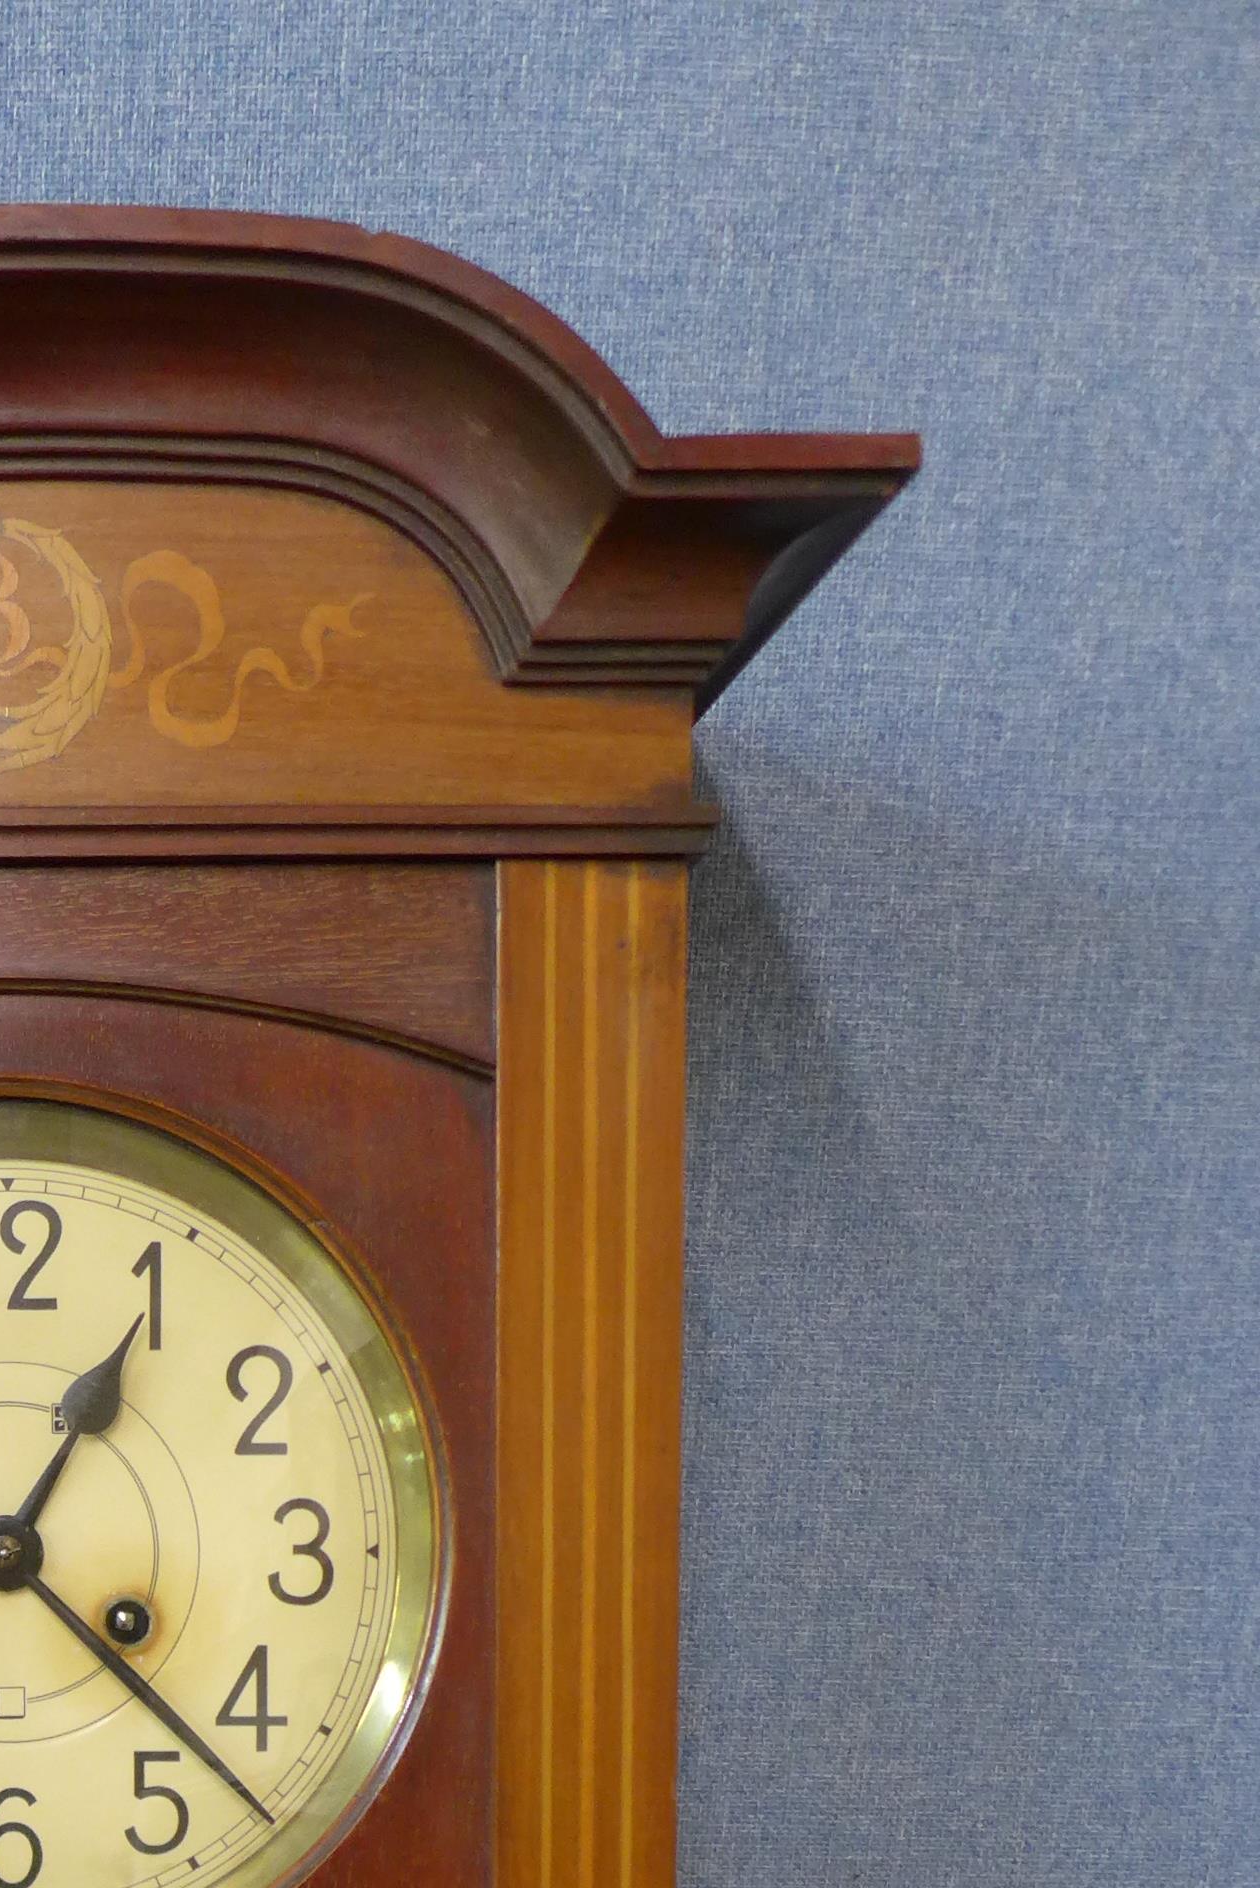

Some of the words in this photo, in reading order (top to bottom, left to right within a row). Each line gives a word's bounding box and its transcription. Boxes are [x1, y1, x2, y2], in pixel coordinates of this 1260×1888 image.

[130, 1241, 161, 1351] 1
[225, 1344, 293, 1456] 2
[267, 1498, 335, 1606] 3
[215, 1645, 288, 1753] 4
[123, 1751, 190, 1856] 5
